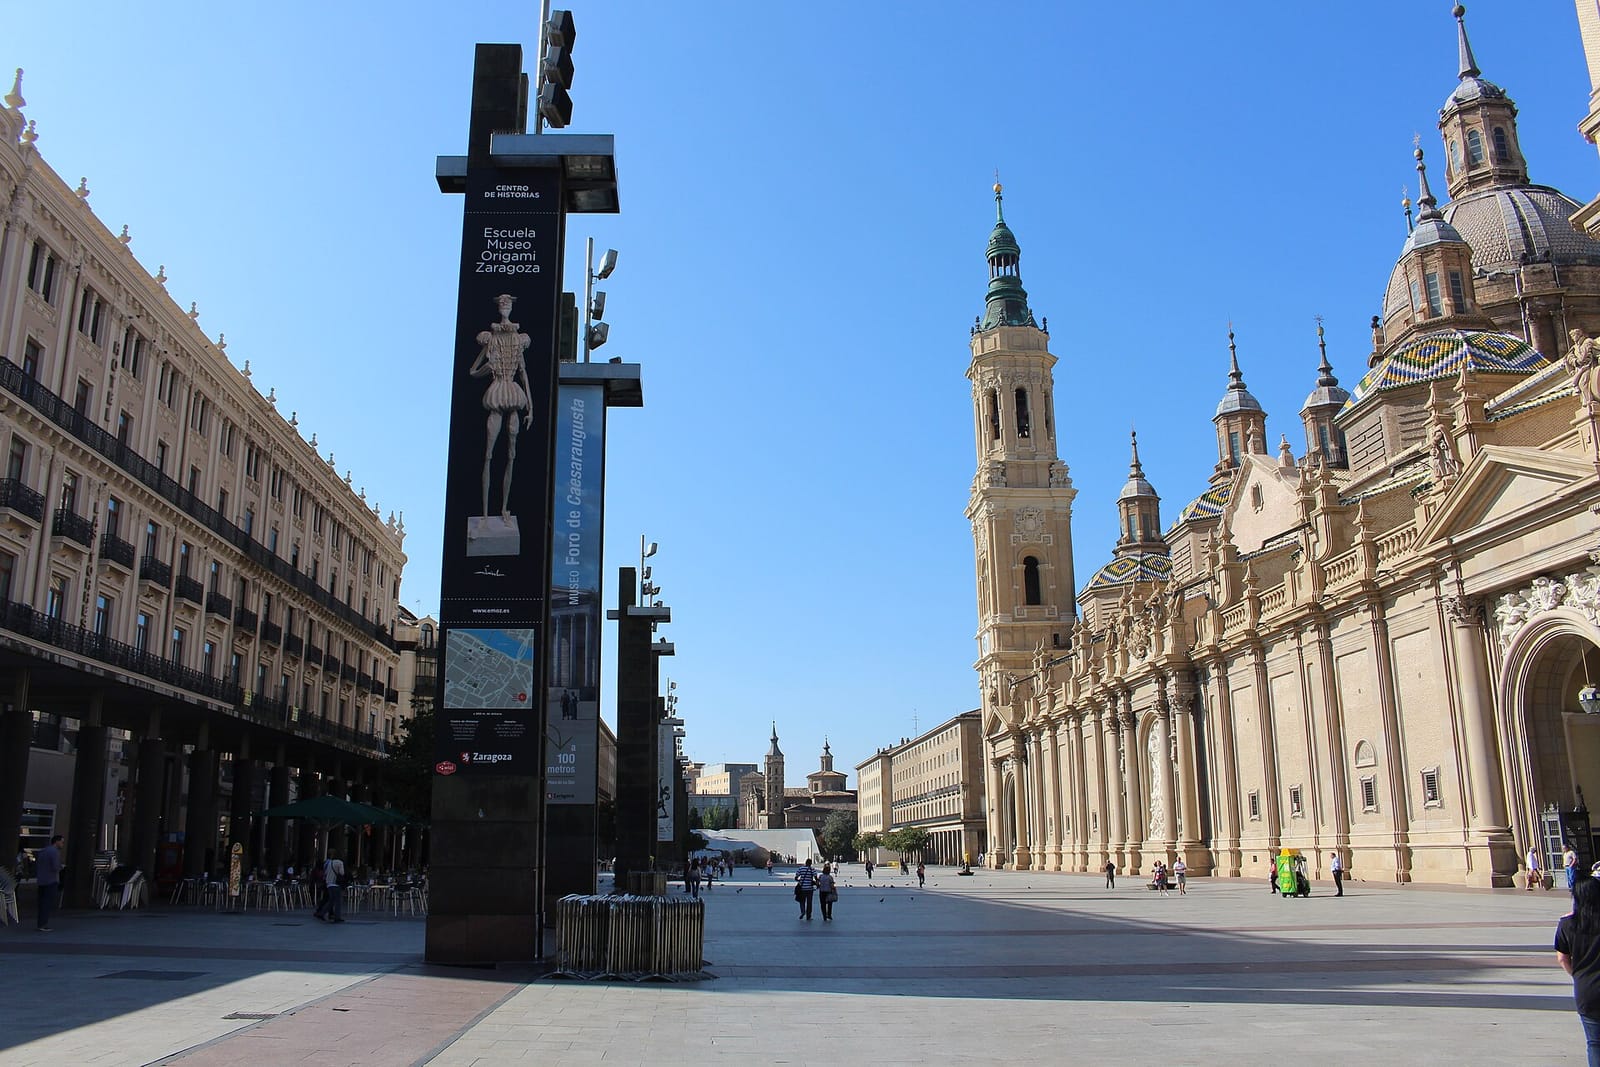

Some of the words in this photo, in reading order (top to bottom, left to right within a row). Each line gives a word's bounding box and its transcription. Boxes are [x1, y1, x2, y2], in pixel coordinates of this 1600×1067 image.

[484, 227, 536, 238] Escuela
[487, 239, 532, 249] Museo
[481, 250, 536, 263] Origami
[475, 262, 540, 274] Zaragoza
[567, 398, 586, 505] Caesaraugusta
[566, 510, 581, 528] de
[565, 535, 580, 565] Foro
[569, 570, 580, 605] MUSEO
[472, 752, 513, 763] Zaragoza
[556, 753, 576, 764] 100
[547, 765, 576, 774] metros
